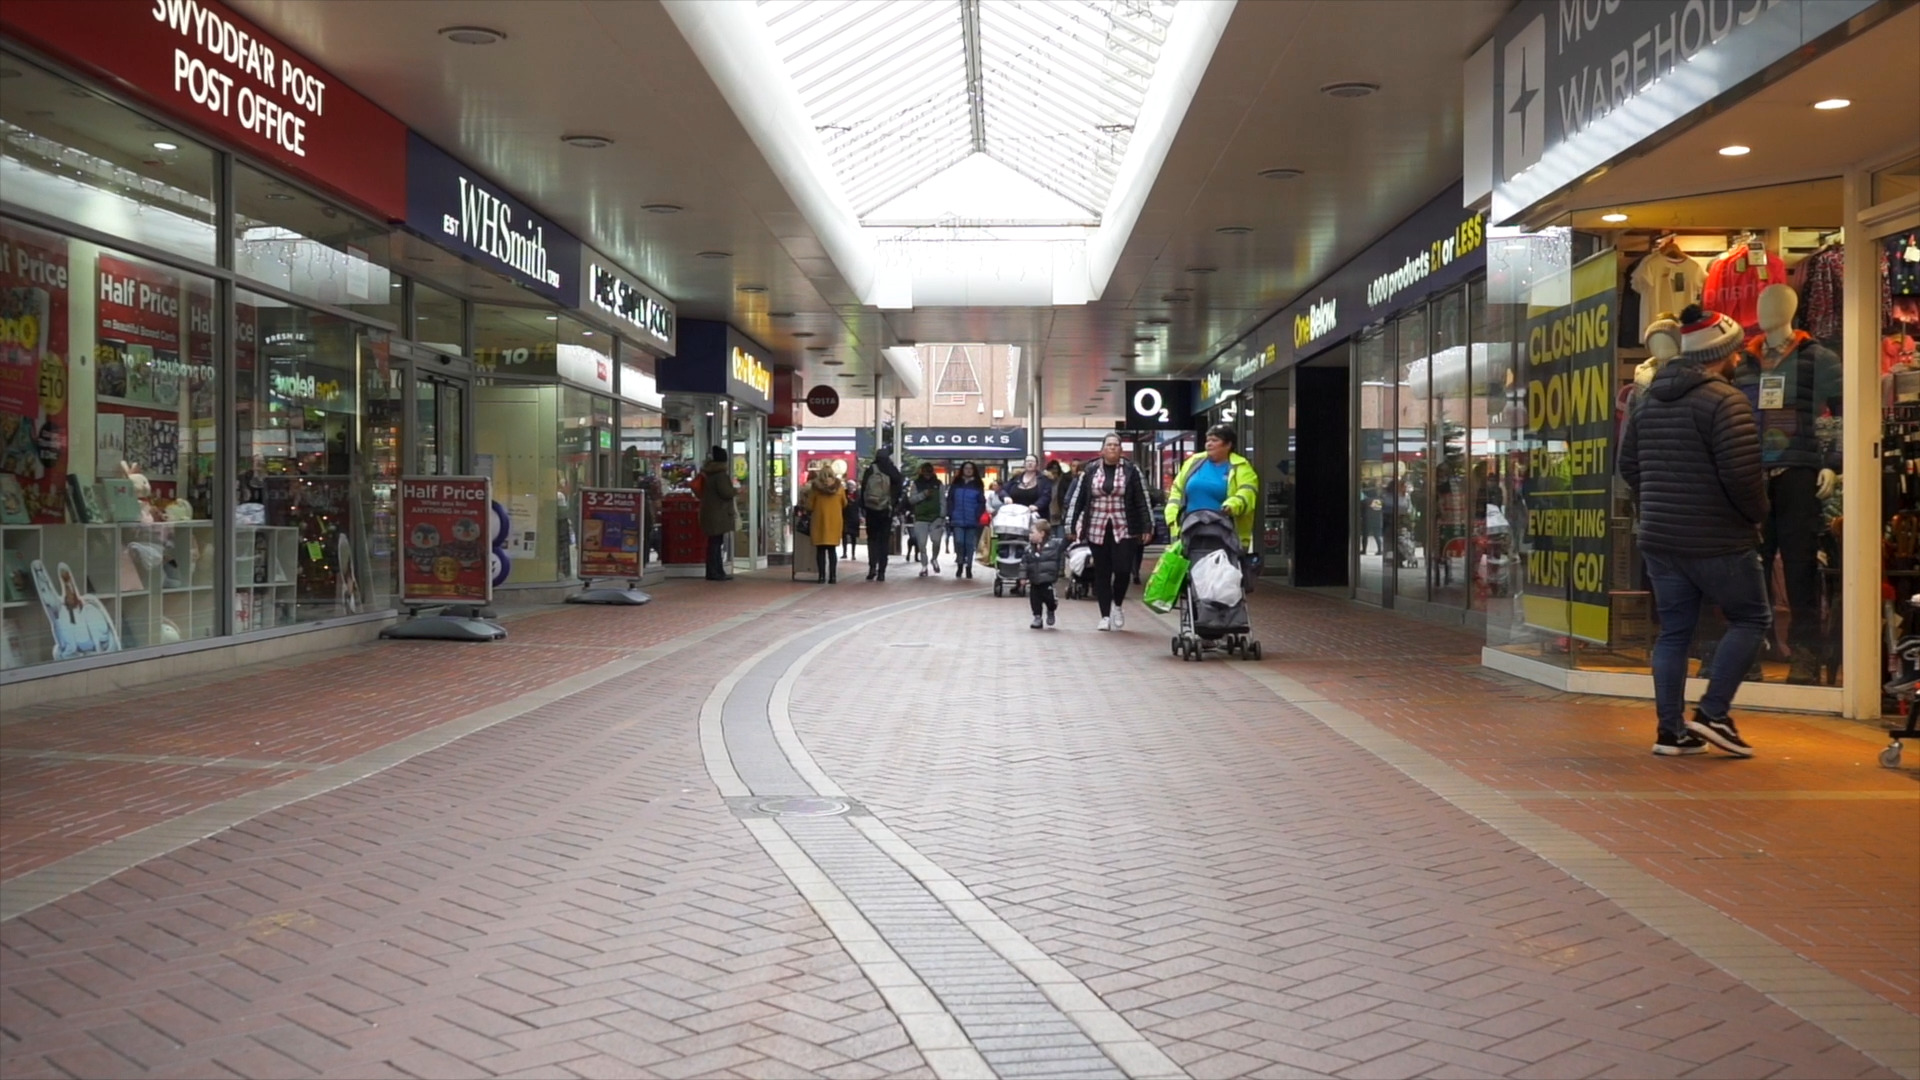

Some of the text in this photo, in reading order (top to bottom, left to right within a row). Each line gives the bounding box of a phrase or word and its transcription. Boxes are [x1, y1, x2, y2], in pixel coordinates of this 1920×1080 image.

[174, 48, 306, 157] POST OFFICE
[282, 59, 325, 116] POST
[443, 213, 459, 237] EST
[459, 176, 547, 283] WHSmith
[17, 248, 67, 289] Price
[1389, 249, 1430, 303] products
[1430, 239, 1442, 272] £1
[1442, 236, 1455, 266] or
[1455, 212, 1483, 258] LESS
[100, 272, 178, 318] Half Price
[1529, 303, 1609, 366] CLOSING
[40, 375, 64, 399] £10
[810, 397, 837, 405] COSTA
[1528, 362, 1609, 432] DOWN
[904, 434, 1011, 444] EACOCKS
[403, 485, 485, 500] Half Price
[587, 492, 598, 505] 3
[603, 493, 614, 506] 2
[1528, 508, 1606, 538] EVERYTHING
[1527, 550, 1606, 593] MUST GO!
